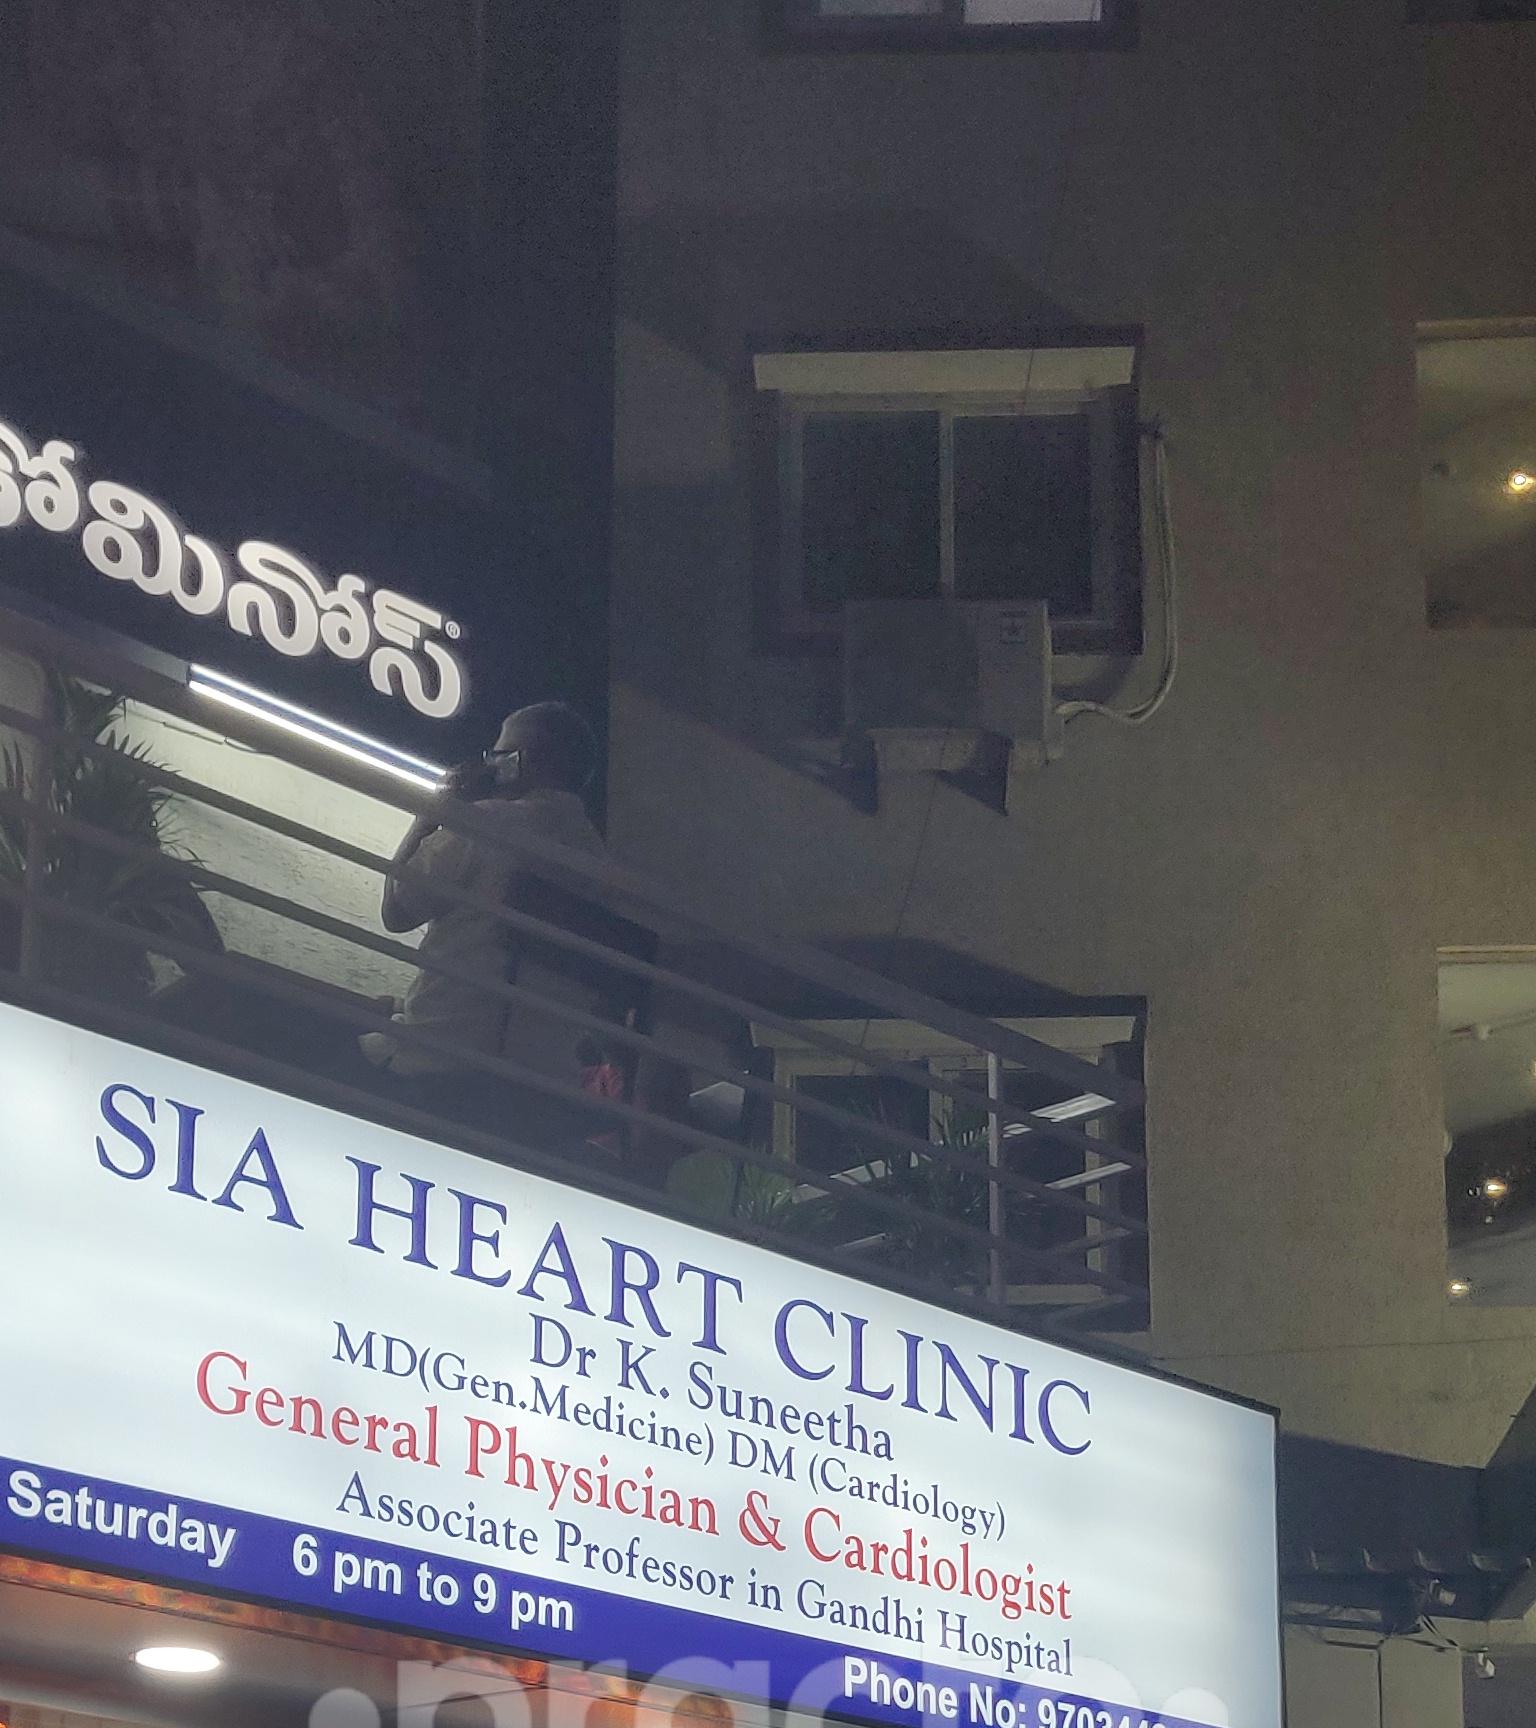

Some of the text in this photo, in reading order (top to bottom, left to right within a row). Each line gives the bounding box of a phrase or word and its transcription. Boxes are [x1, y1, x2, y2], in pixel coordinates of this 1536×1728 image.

[95, 1083, 1092, 1456] SIA HEART CLINIC
[197, 1351, 1074, 1620] General Physician & Cardiologist
[332, 1320, 1007, 1542] MD(Gen.Medicine) DM (Cardiology)
[529, 1312, 895, 1461] Dr K. Suneetha
[5, 1469, 238, 1569] Saturday
[291, 1532, 320, 1578] 6
[333, 1549, 403, 1596] pm
[417, 1561, 461, 1606] to
[472, 1573, 498, 1614] 9
[510, 1589, 576, 1632] pm
[336, 1470, 1074, 1678] Associate Professor in Gandhi Hospital
[843, 1656, 960, 1719] Phone
